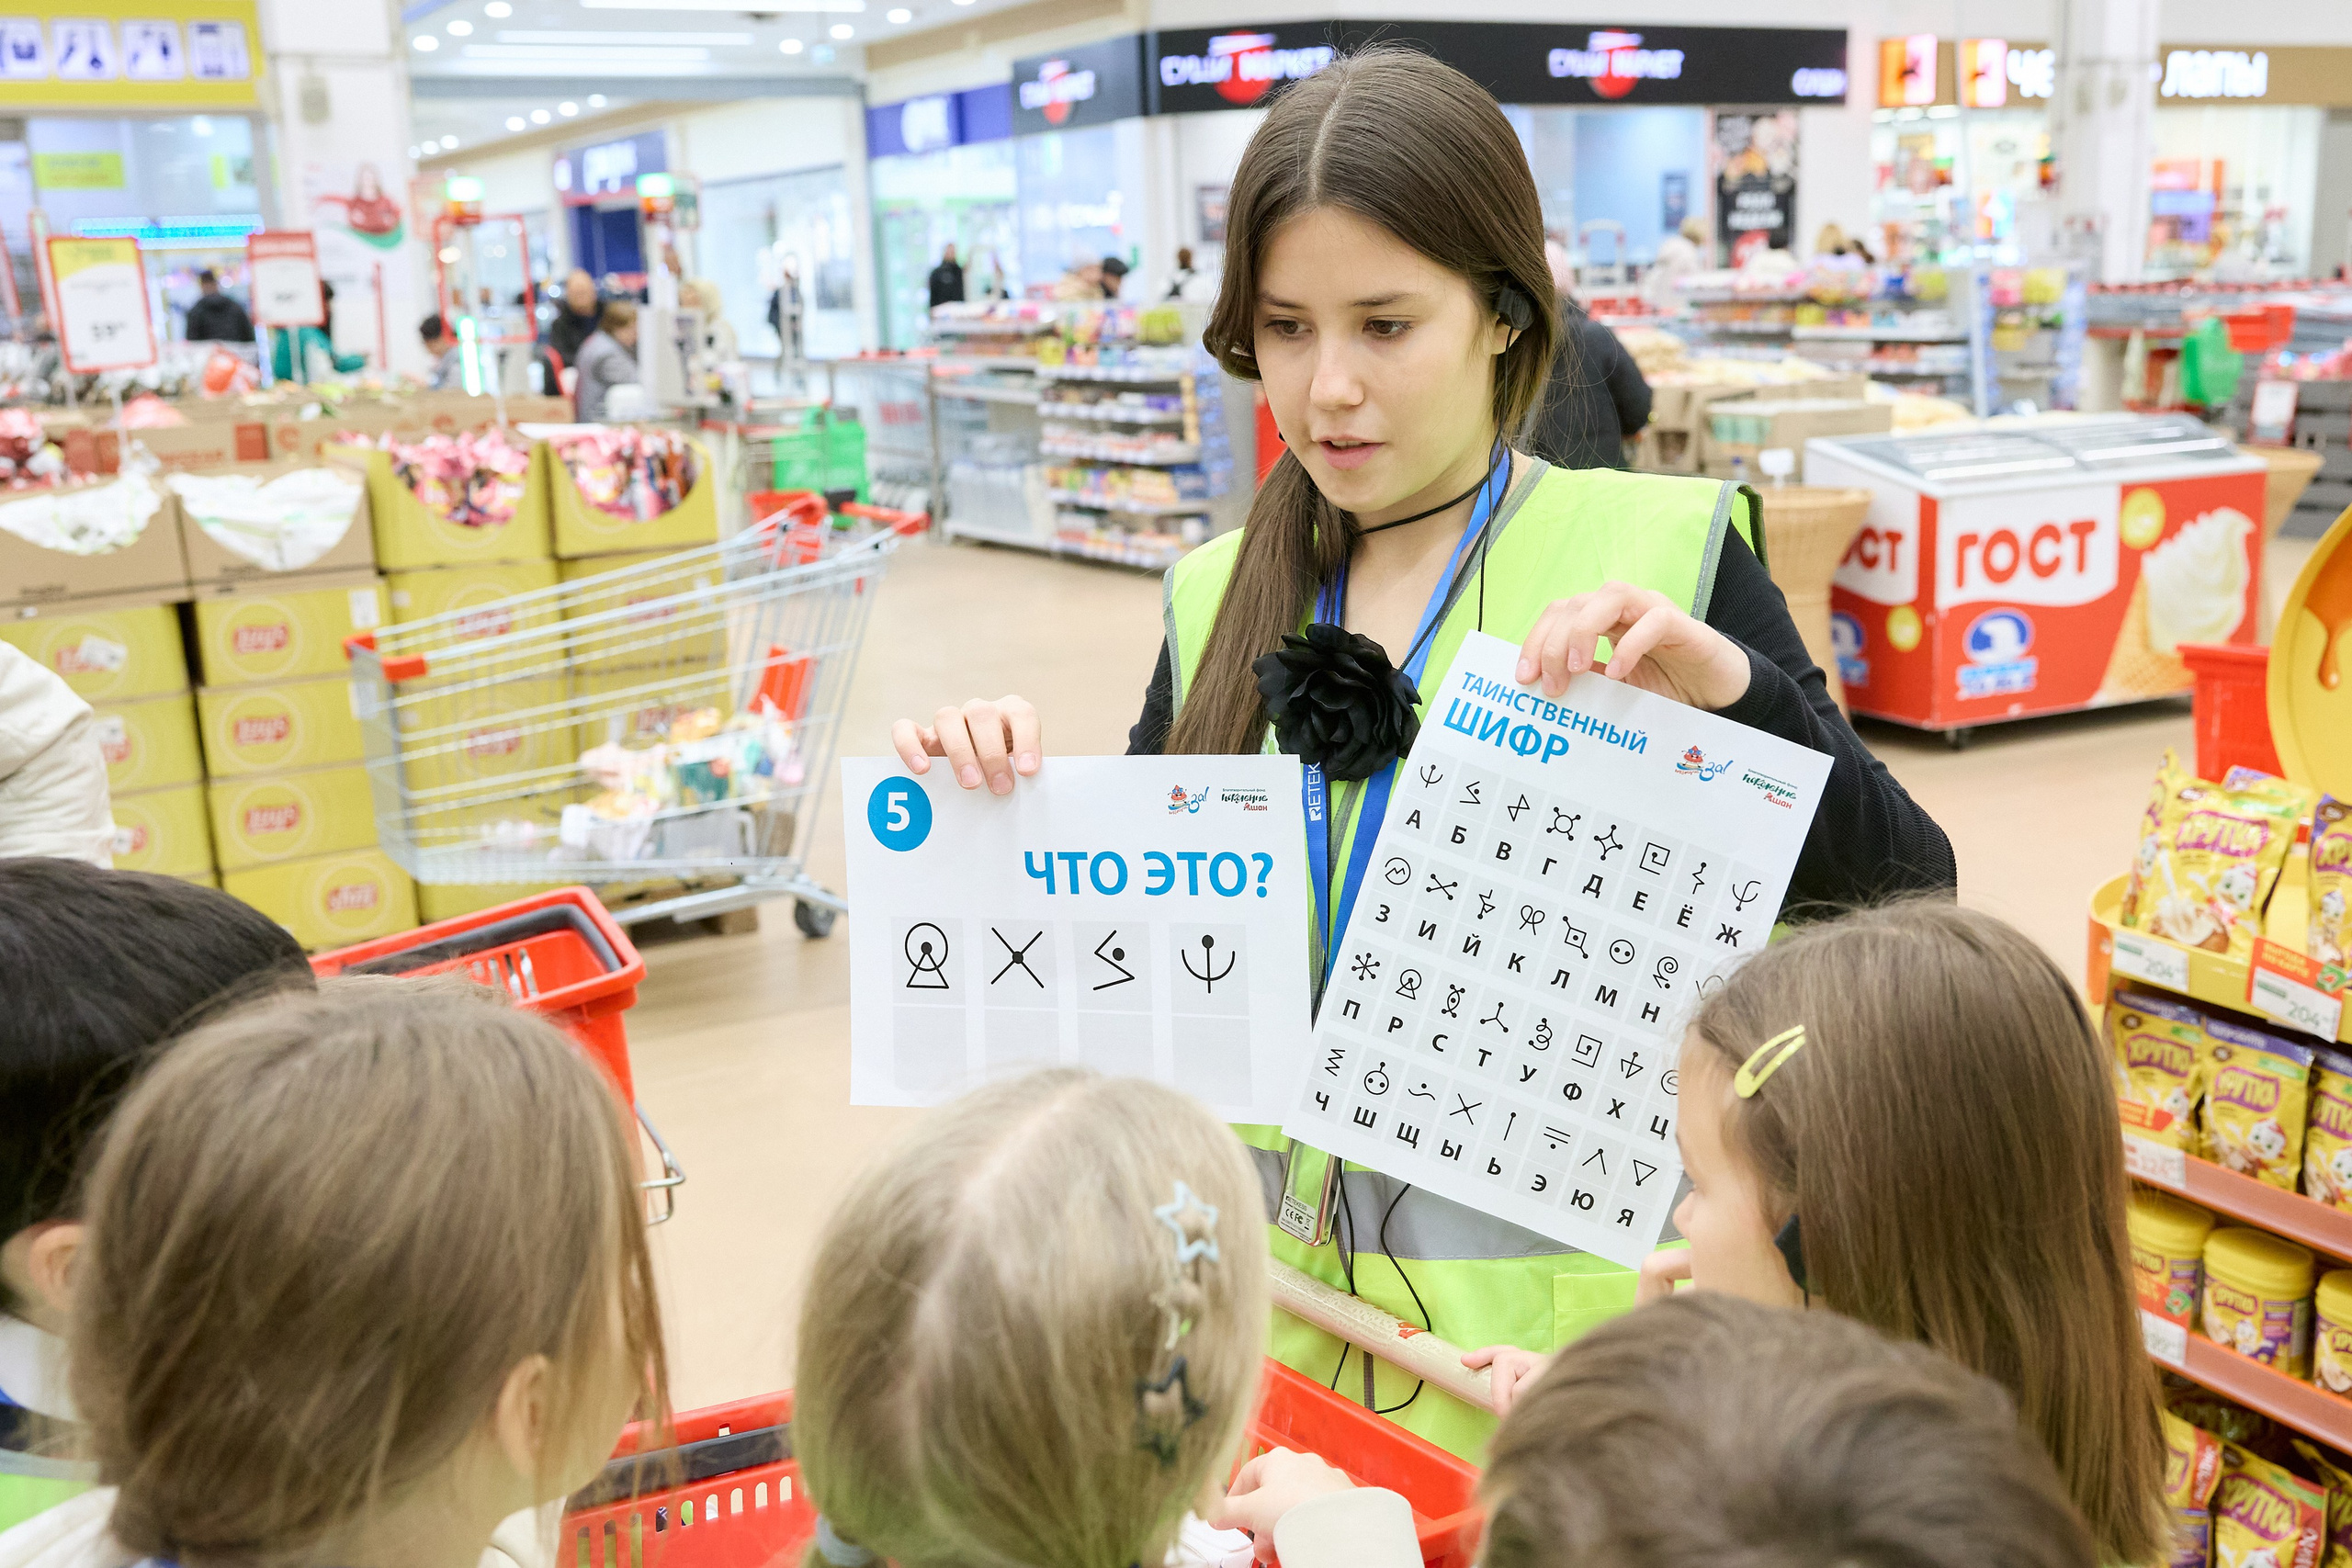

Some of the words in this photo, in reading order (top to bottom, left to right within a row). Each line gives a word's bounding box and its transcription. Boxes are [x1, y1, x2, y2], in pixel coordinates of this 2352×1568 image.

[1956, 520, 2098, 591] ГОСТ
[1442, 697, 1570, 764] ШИФР
[1462, 671, 1648, 754] ТАИНСТВЕННЫЙ
[885, 791, 910, 832] 5
[1307, 761, 1322, 822] RETEK
[1024, 851, 1128, 897] ЧТО
[1143, 851, 1274, 898] ЭТО?
[1405, 809, 1420, 829] А
[1450, 825, 1467, 844] Б
[1495, 840, 1512, 861] В
[1541, 857, 1557, 875] Г
[1581, 874, 1604, 899] Д
[1632, 890, 1649, 911] Е
[1677, 904, 1695, 930] Ё
[1715, 922, 1742, 948] Ж
[1374, 904, 1391, 923] З
[1418, 919, 1437, 941] И
[1462, 932, 1482, 957] Й
[1507, 952, 1526, 974] К
[1550, 968, 1570, 989] Л
[1594, 984, 1618, 1008] М
[1640, 1001, 1661, 1023] Н
[1342, 998, 1362, 1021] П
[1387, 1016, 1404, 1033] Р
[1431, 1033, 1449, 1053] С
[1478, 1048, 1493, 1067] Т
[1519, 1064, 1538, 1083] У
[1563, 1082, 1582, 1101] Ф
[1606, 1098, 1626, 1120] Х
[1649, 1114, 1669, 1141] Ц
[1315, 1090, 1330, 1111] Ч
[1352, 1106, 1377, 1129] Ш
[1396, 1122, 1420, 1149] Щ
[1440, 1139, 1463, 1161] Ы
[1487, 1156, 1501, 1176] Ь
[1531, 1174, 1547, 1192] Э
[1570, 1189, 1595, 1211] Ю
[1616, 1208, 1634, 1227] Я
